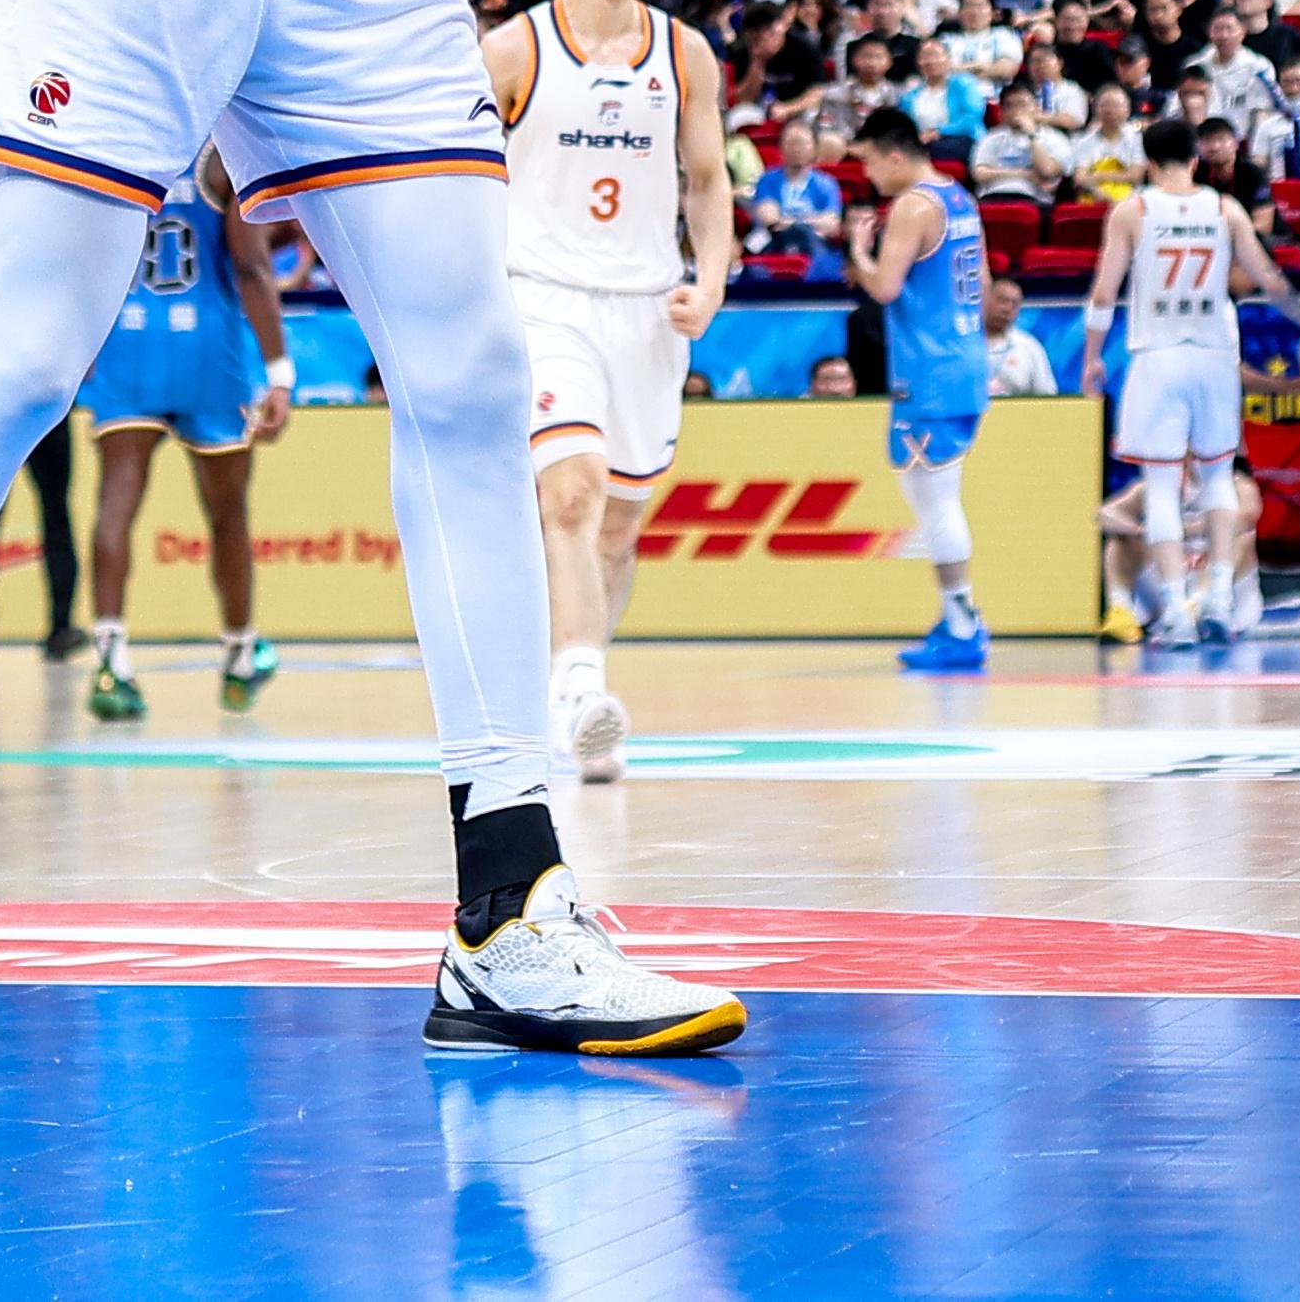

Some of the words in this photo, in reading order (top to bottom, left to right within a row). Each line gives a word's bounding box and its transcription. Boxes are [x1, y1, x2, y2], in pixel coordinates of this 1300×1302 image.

[558, 128, 653, 150] sharks
[589, 177, 621, 224] 3
[1155, 246, 1215, 291] 77
[634, 478, 883, 561] HL
[155, 529, 342, 564] Deered
[354, 529, 400, 571] by
